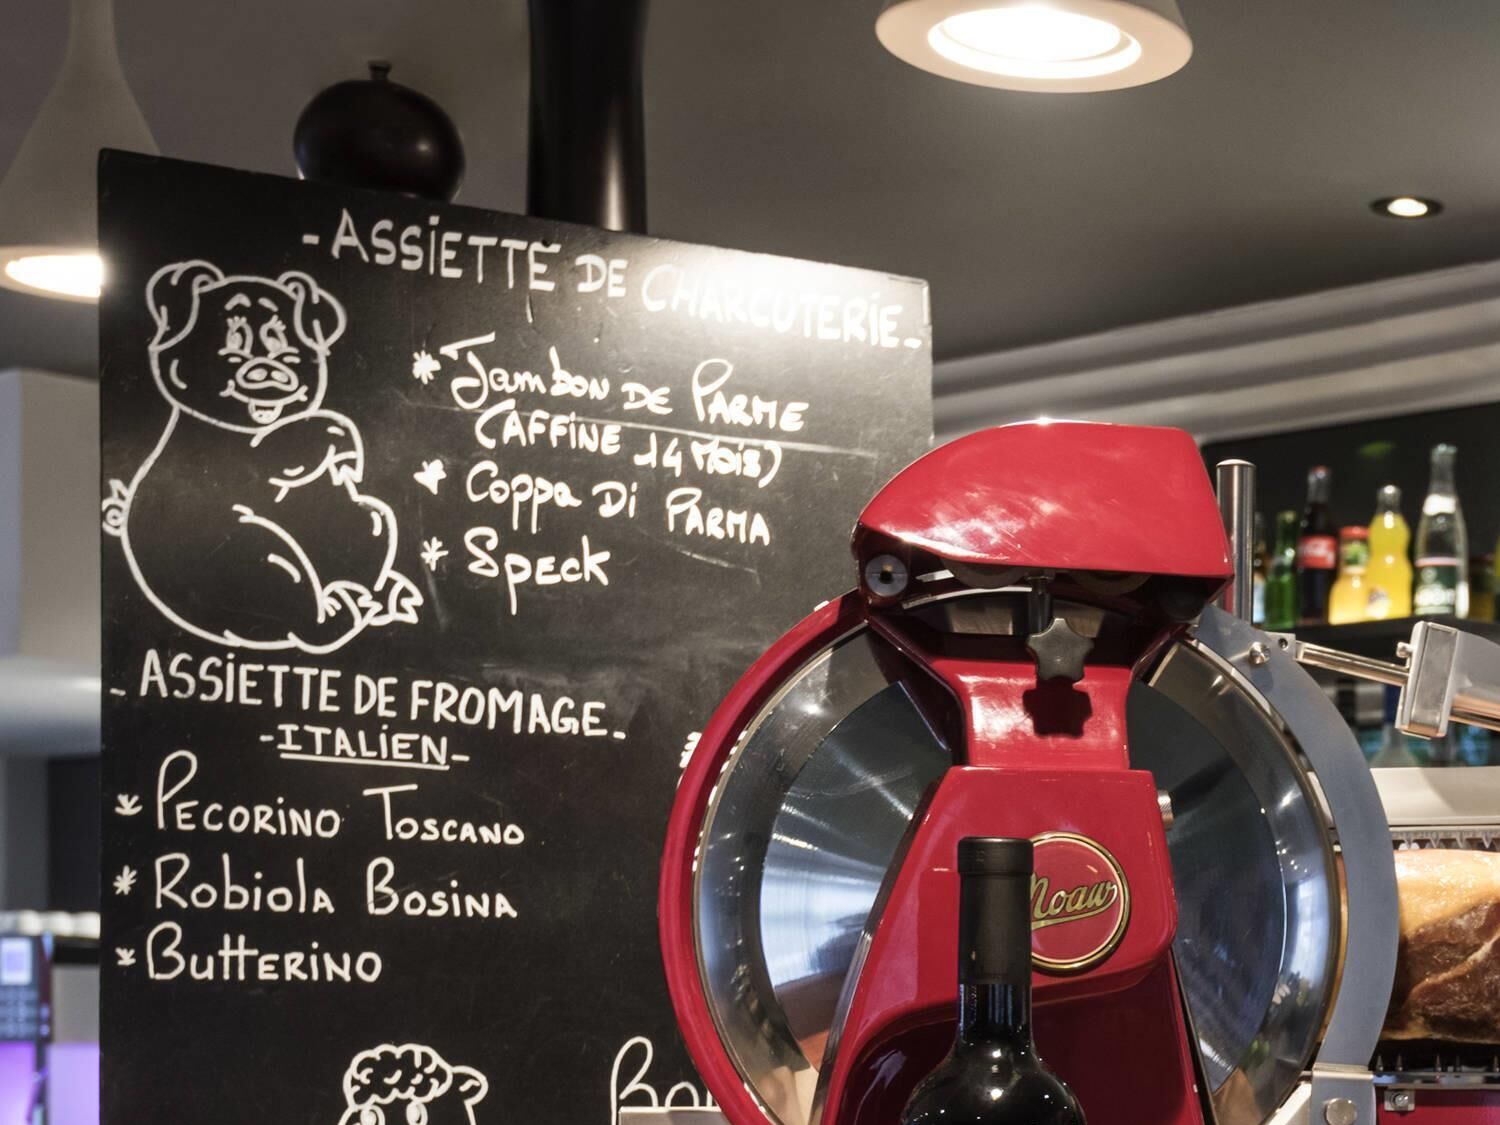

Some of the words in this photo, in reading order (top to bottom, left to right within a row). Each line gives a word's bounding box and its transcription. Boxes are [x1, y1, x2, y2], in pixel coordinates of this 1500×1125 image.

[575, 253, 629, 297] DE
[621, 382, 673, 415] DE
[354, 674, 399, 718] DE
